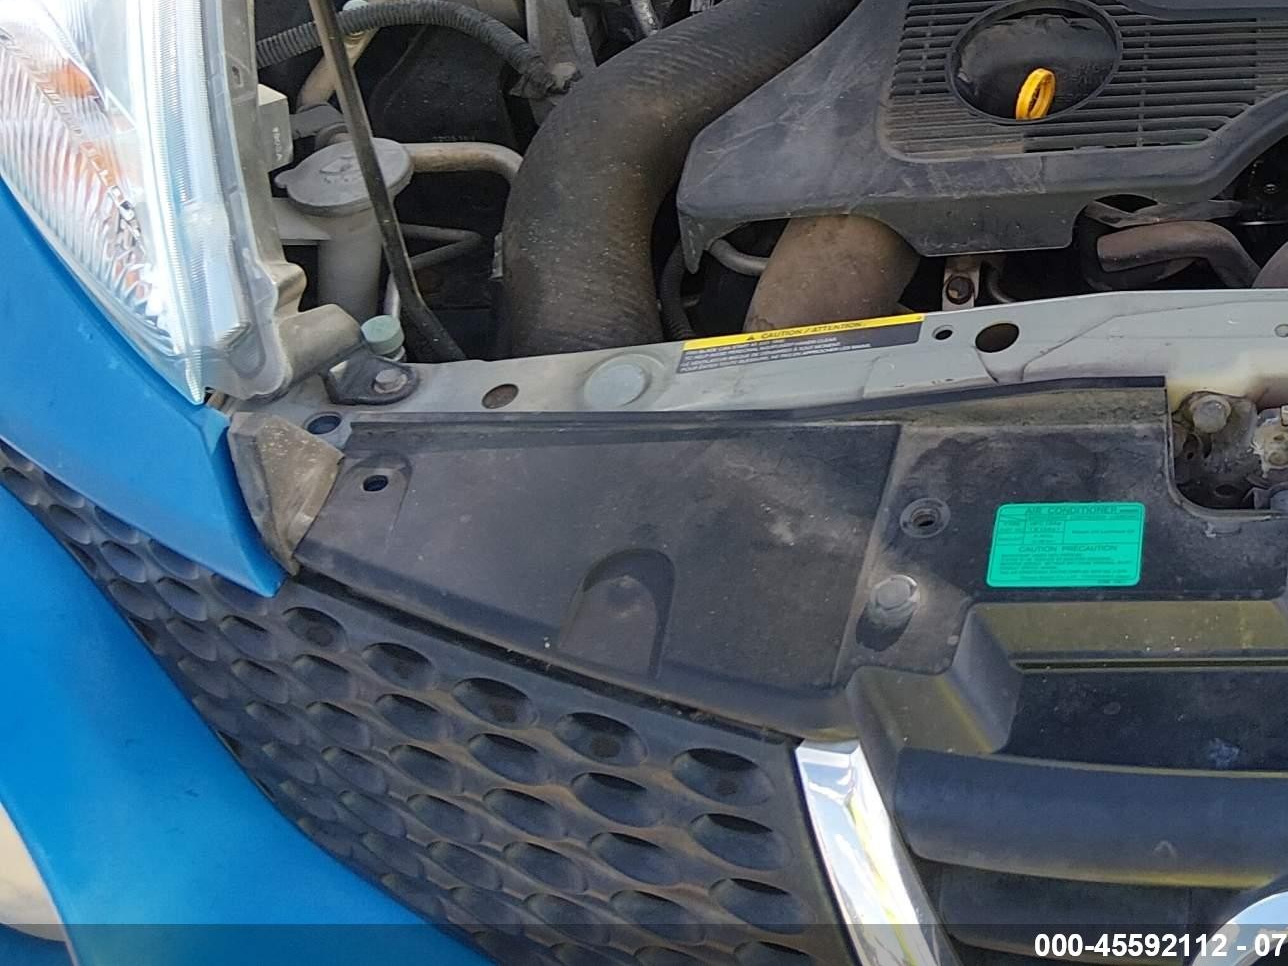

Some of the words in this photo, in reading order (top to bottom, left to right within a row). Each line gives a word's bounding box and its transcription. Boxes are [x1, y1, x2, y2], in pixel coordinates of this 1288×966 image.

[761, 327, 803, 339] CAUTION
[811, 321, 862, 334] ATTENTION
[1025, 507, 1043, 515] AIR
[1048, 506, 1118, 515] CONDITIONER
[1018, 545, 1057, 553] CAUTION
[1062, 544, 1118, 552] PRECAUTION
